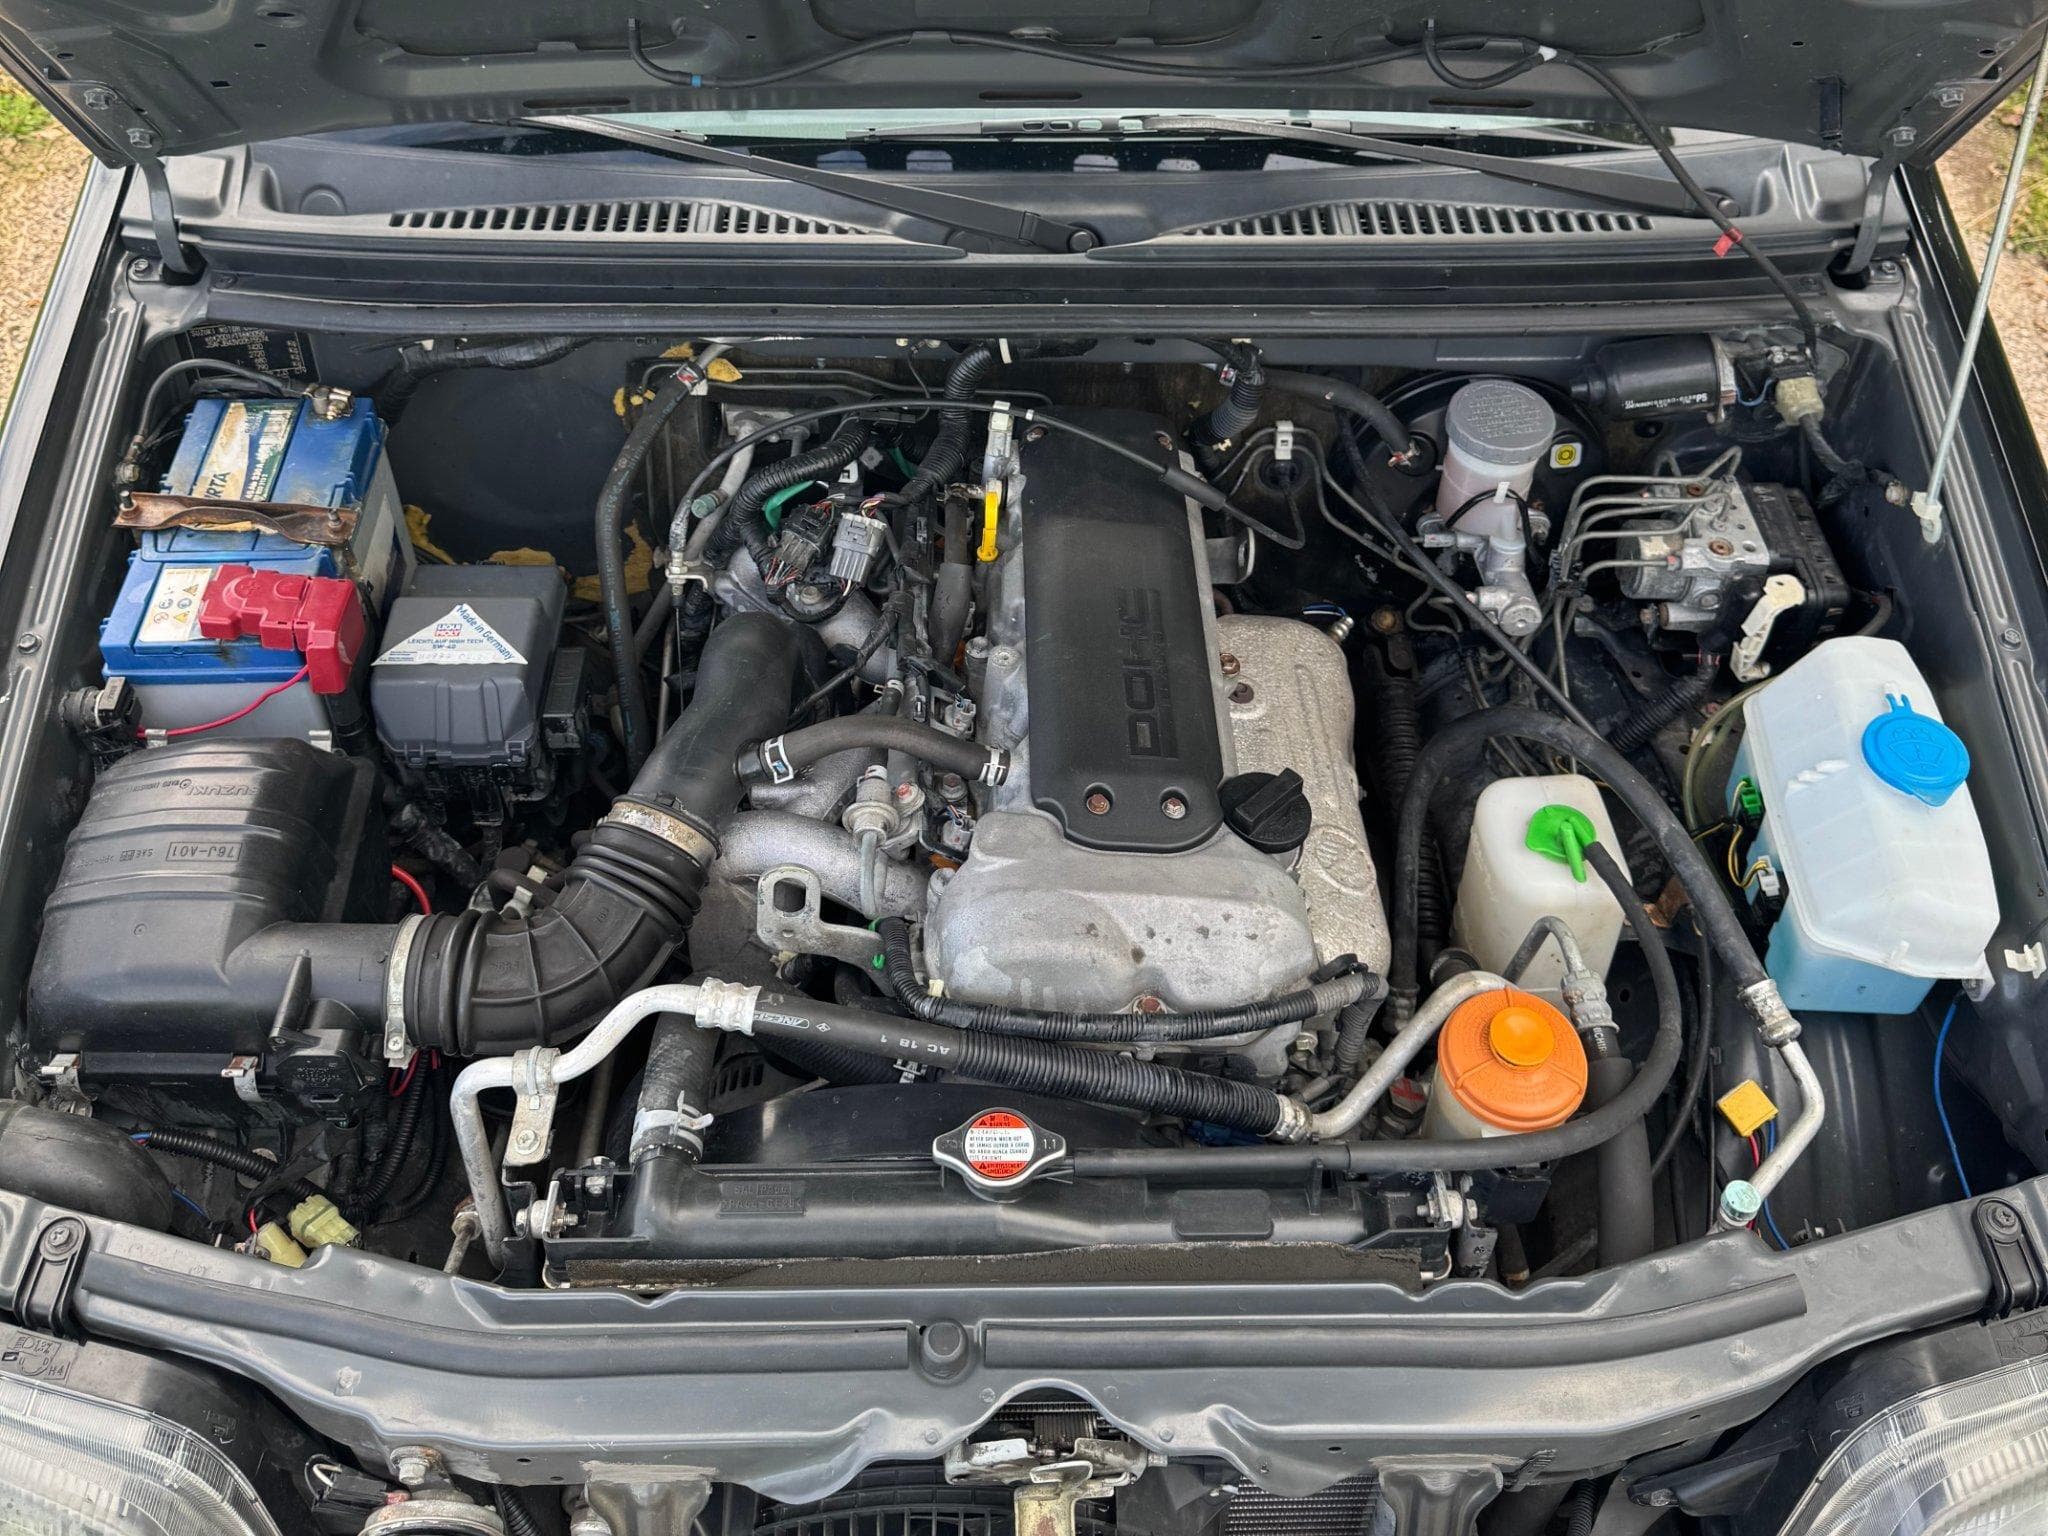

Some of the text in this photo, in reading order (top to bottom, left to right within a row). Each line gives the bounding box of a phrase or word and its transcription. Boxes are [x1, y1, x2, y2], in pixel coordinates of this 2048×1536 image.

[457, 604, 477, 631] Made
[475, 624, 484, 634] in
[482, 630, 515, 661] Germany
[170, 845, 236, 858] 76J-A01
[926, 1043, 950, 1055] AC
[1043, 1138, 1057, 1150] 1.1
